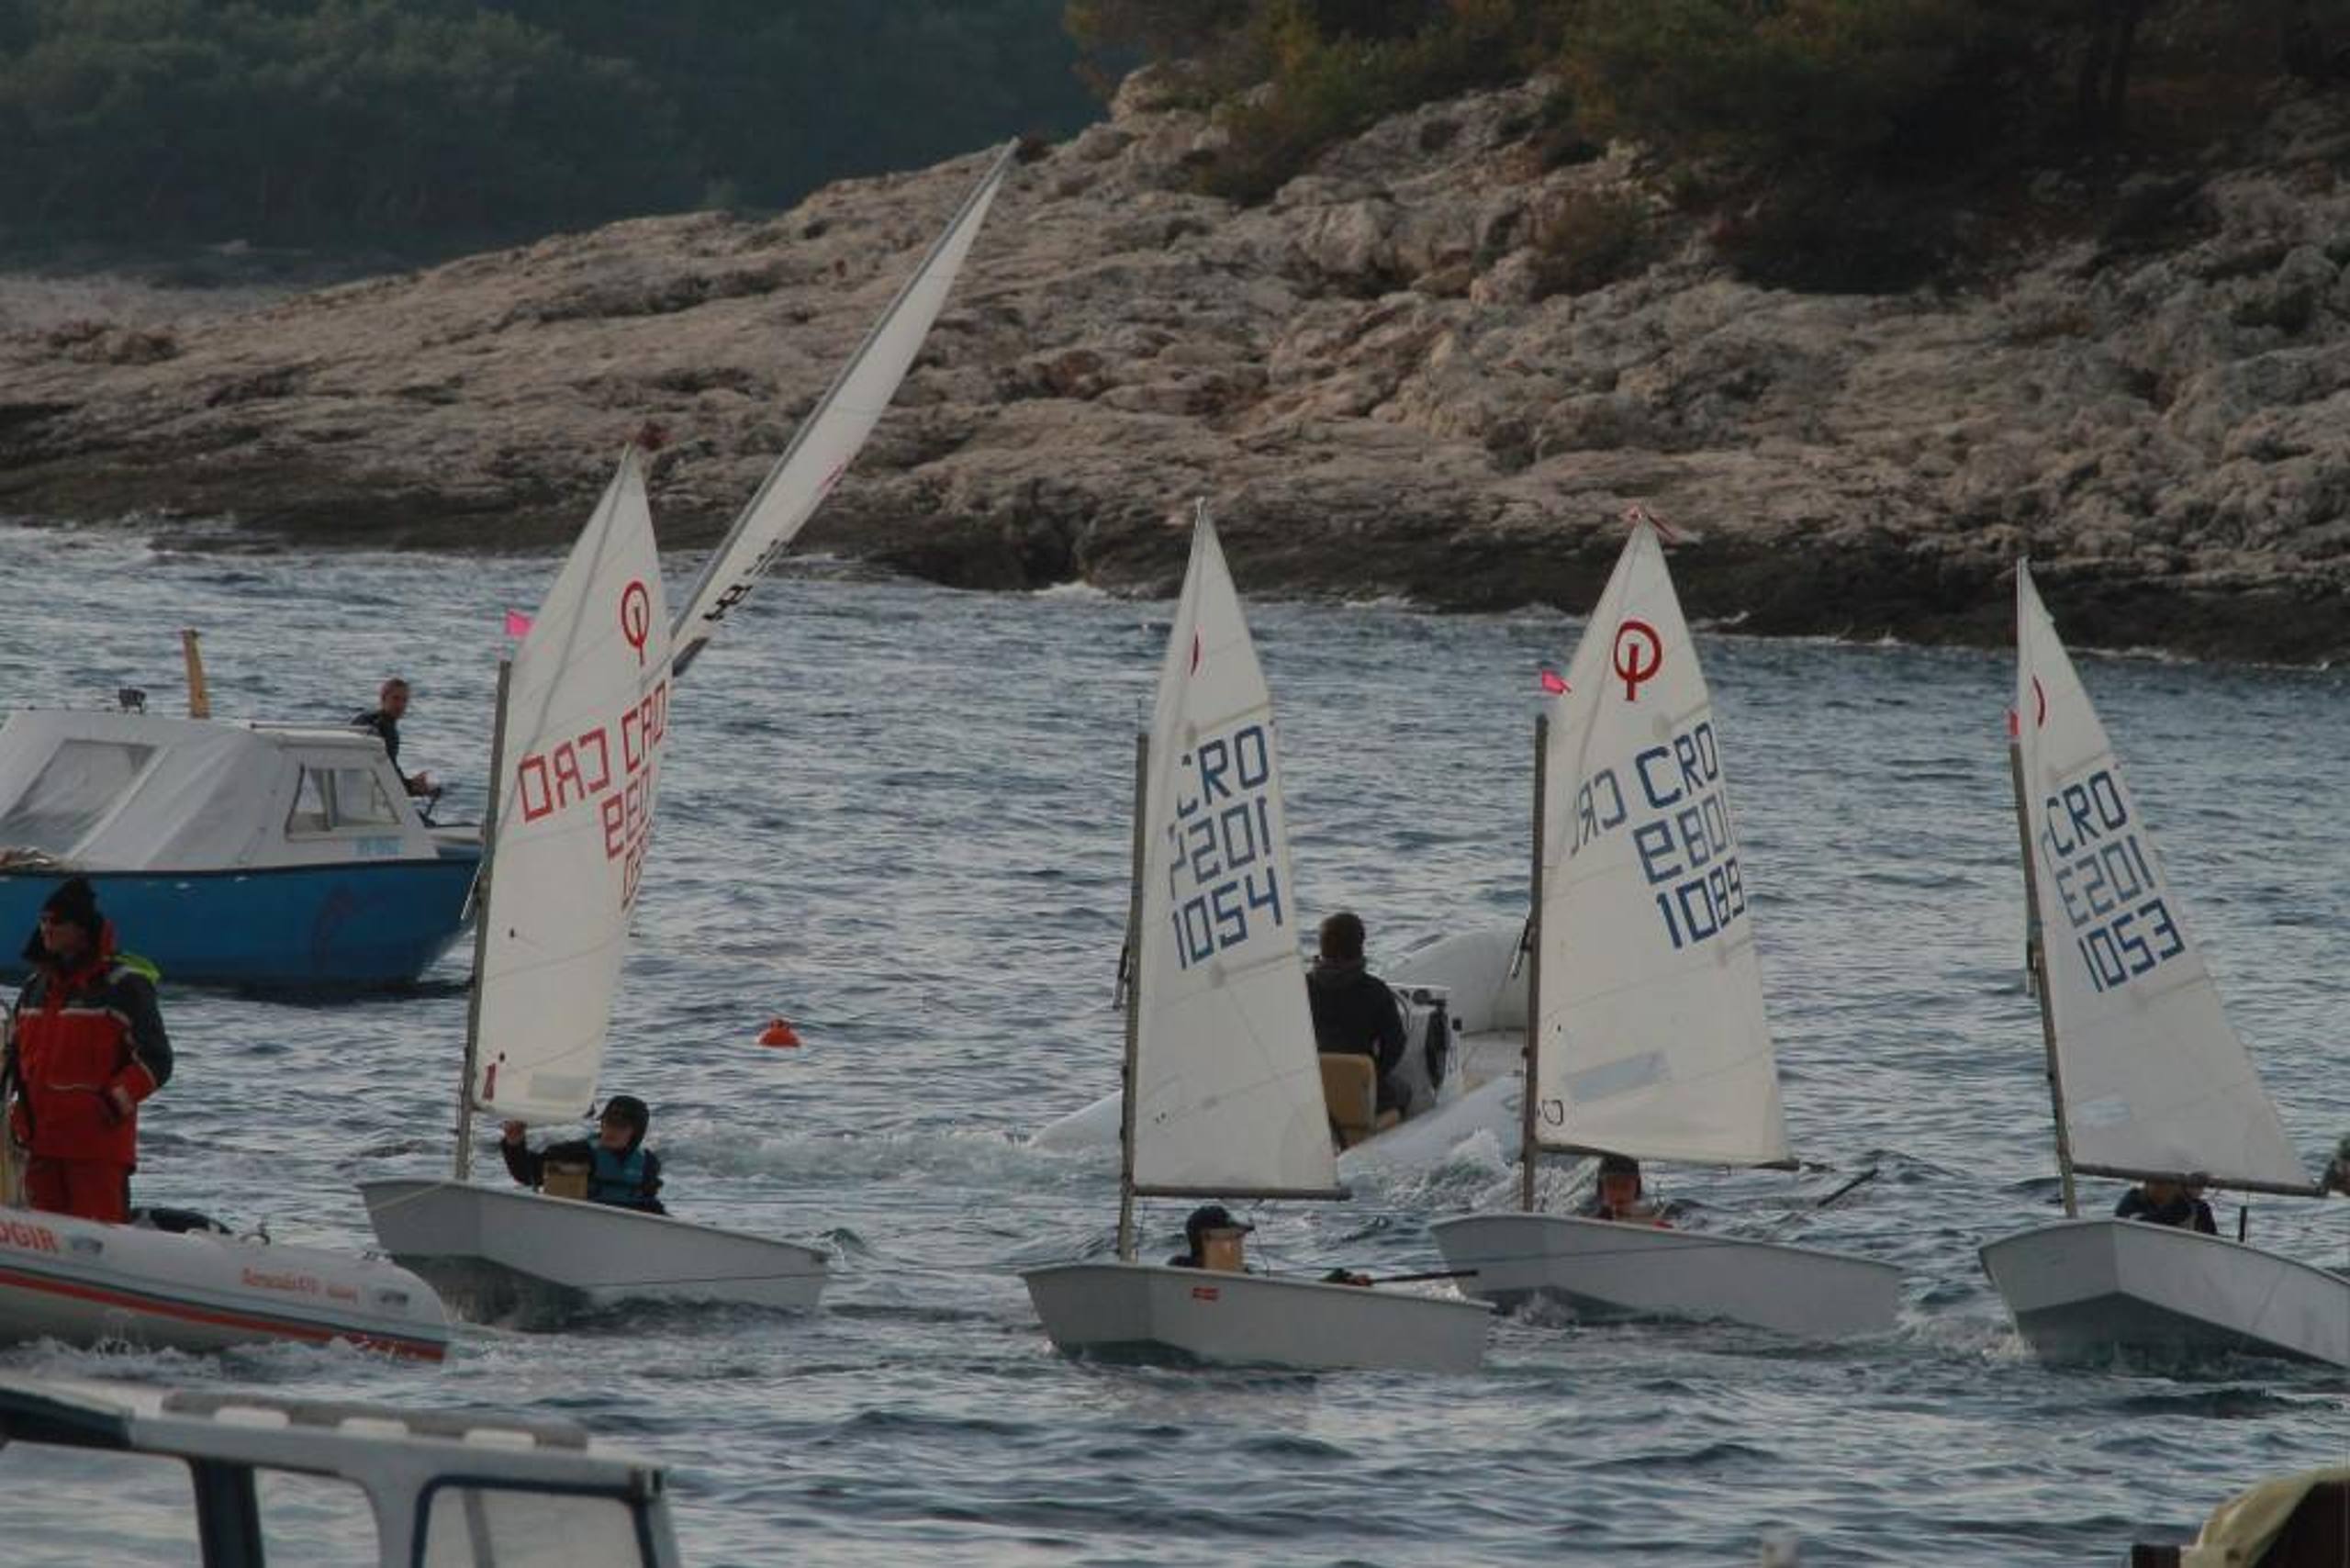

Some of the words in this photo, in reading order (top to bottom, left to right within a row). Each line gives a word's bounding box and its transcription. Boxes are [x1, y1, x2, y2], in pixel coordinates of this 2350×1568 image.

[1635, 721, 1718, 809] CRO
[2046, 769, 2128, 857] CRO
[1171, 866, 1283, 970] 1054
[1656, 857, 1746, 949] 1089
[2076, 897, 2186, 993] 1053
